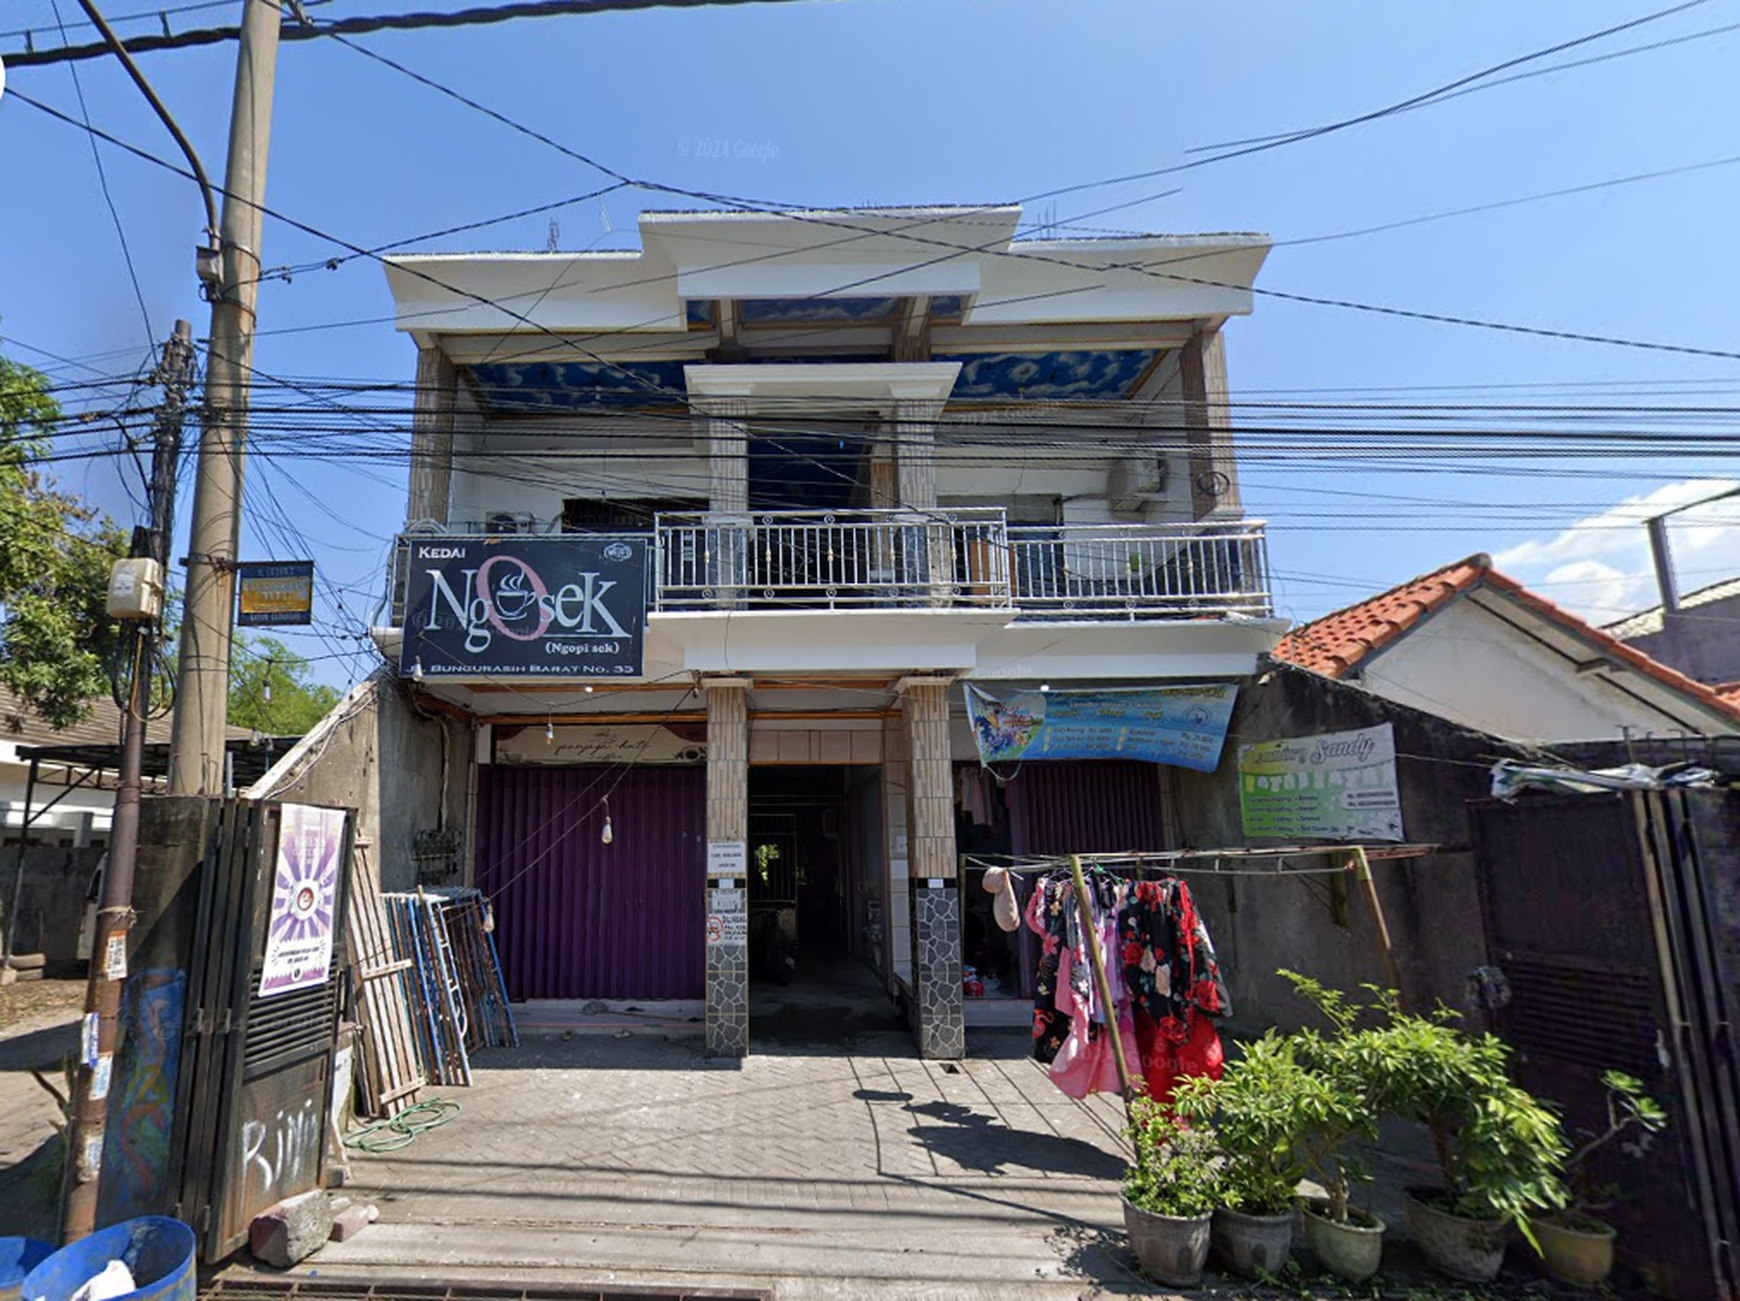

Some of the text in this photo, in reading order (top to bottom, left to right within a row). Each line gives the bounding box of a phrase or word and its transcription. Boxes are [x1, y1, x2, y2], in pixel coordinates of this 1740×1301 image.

[418, 546, 466, 559] KEDAI
[545, 642, 619, 654] (Ngopi sek)
[406, 665, 426, 673] J.
[530, 665, 581, 673] BARAT
[613, 665, 634, 674] 33
[1309, 733, 1375, 765] Sandy
